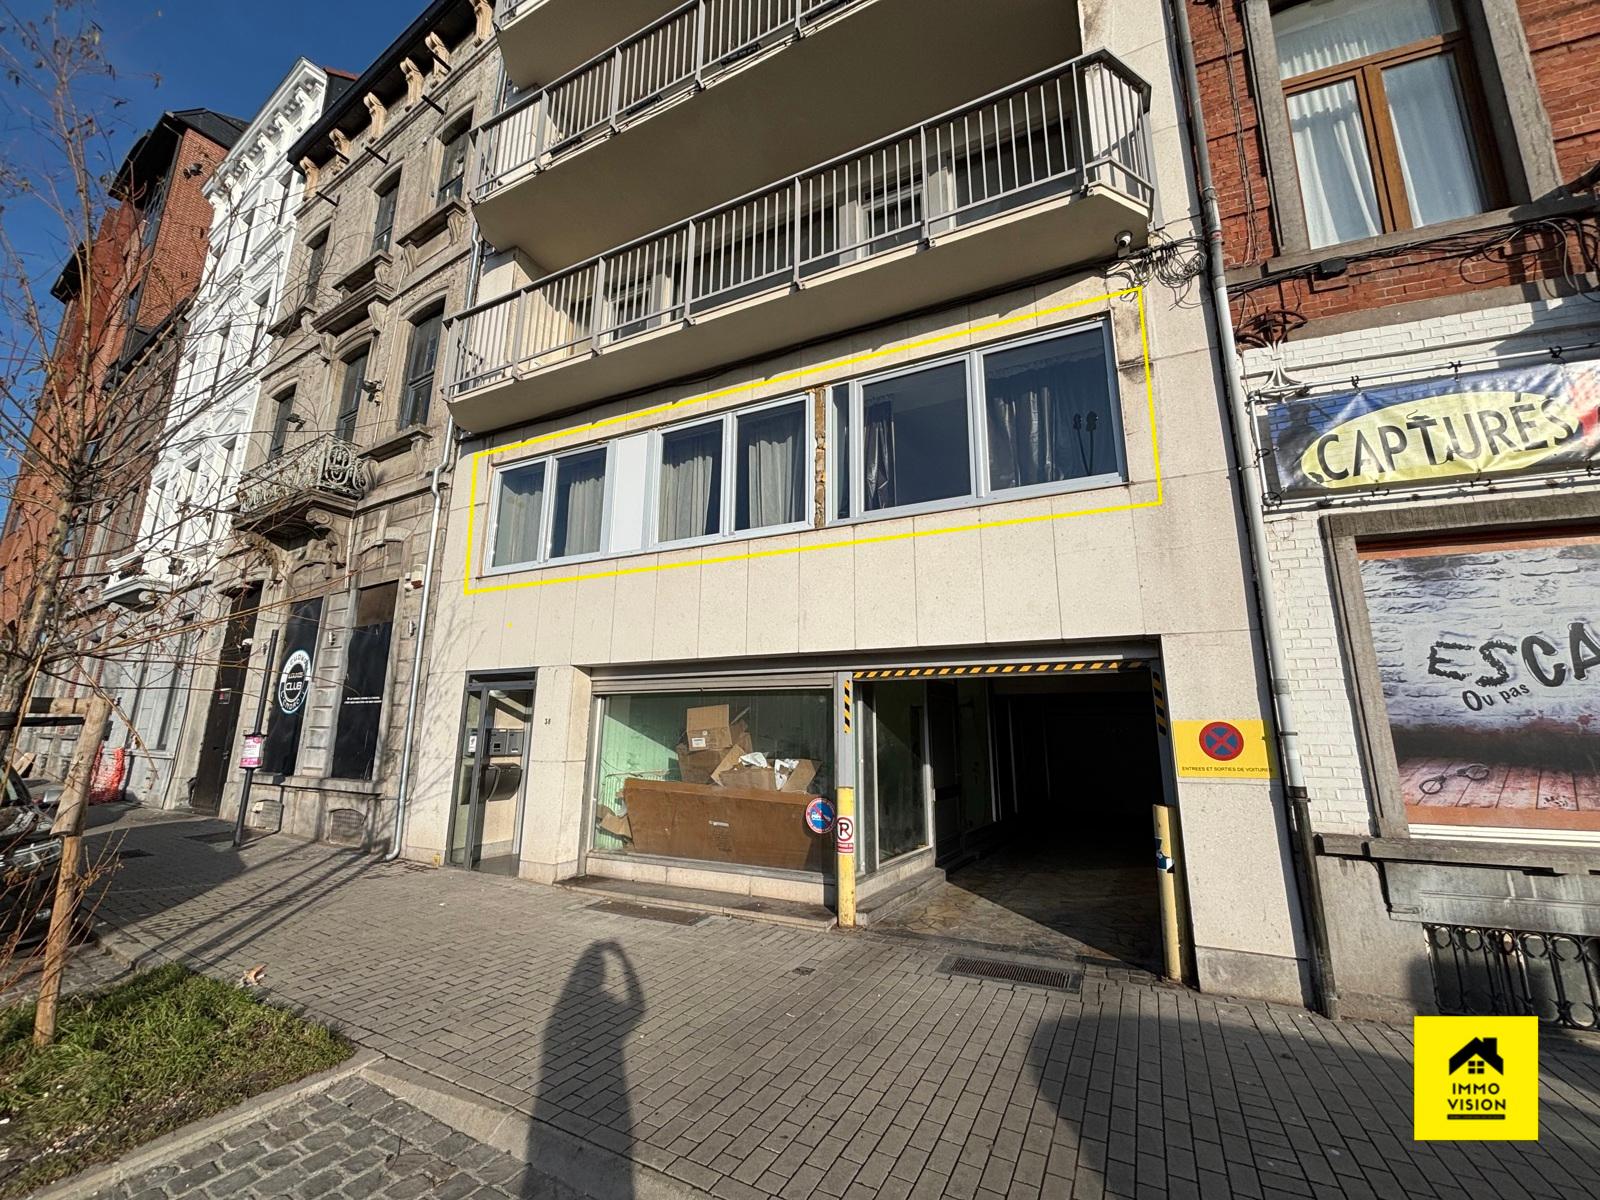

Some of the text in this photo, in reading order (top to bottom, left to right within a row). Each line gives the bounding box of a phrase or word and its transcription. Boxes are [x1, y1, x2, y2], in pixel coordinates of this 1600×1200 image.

[285, 681, 303, 691] CLUB
[1462, 683, 1530, 711] Ou pas
